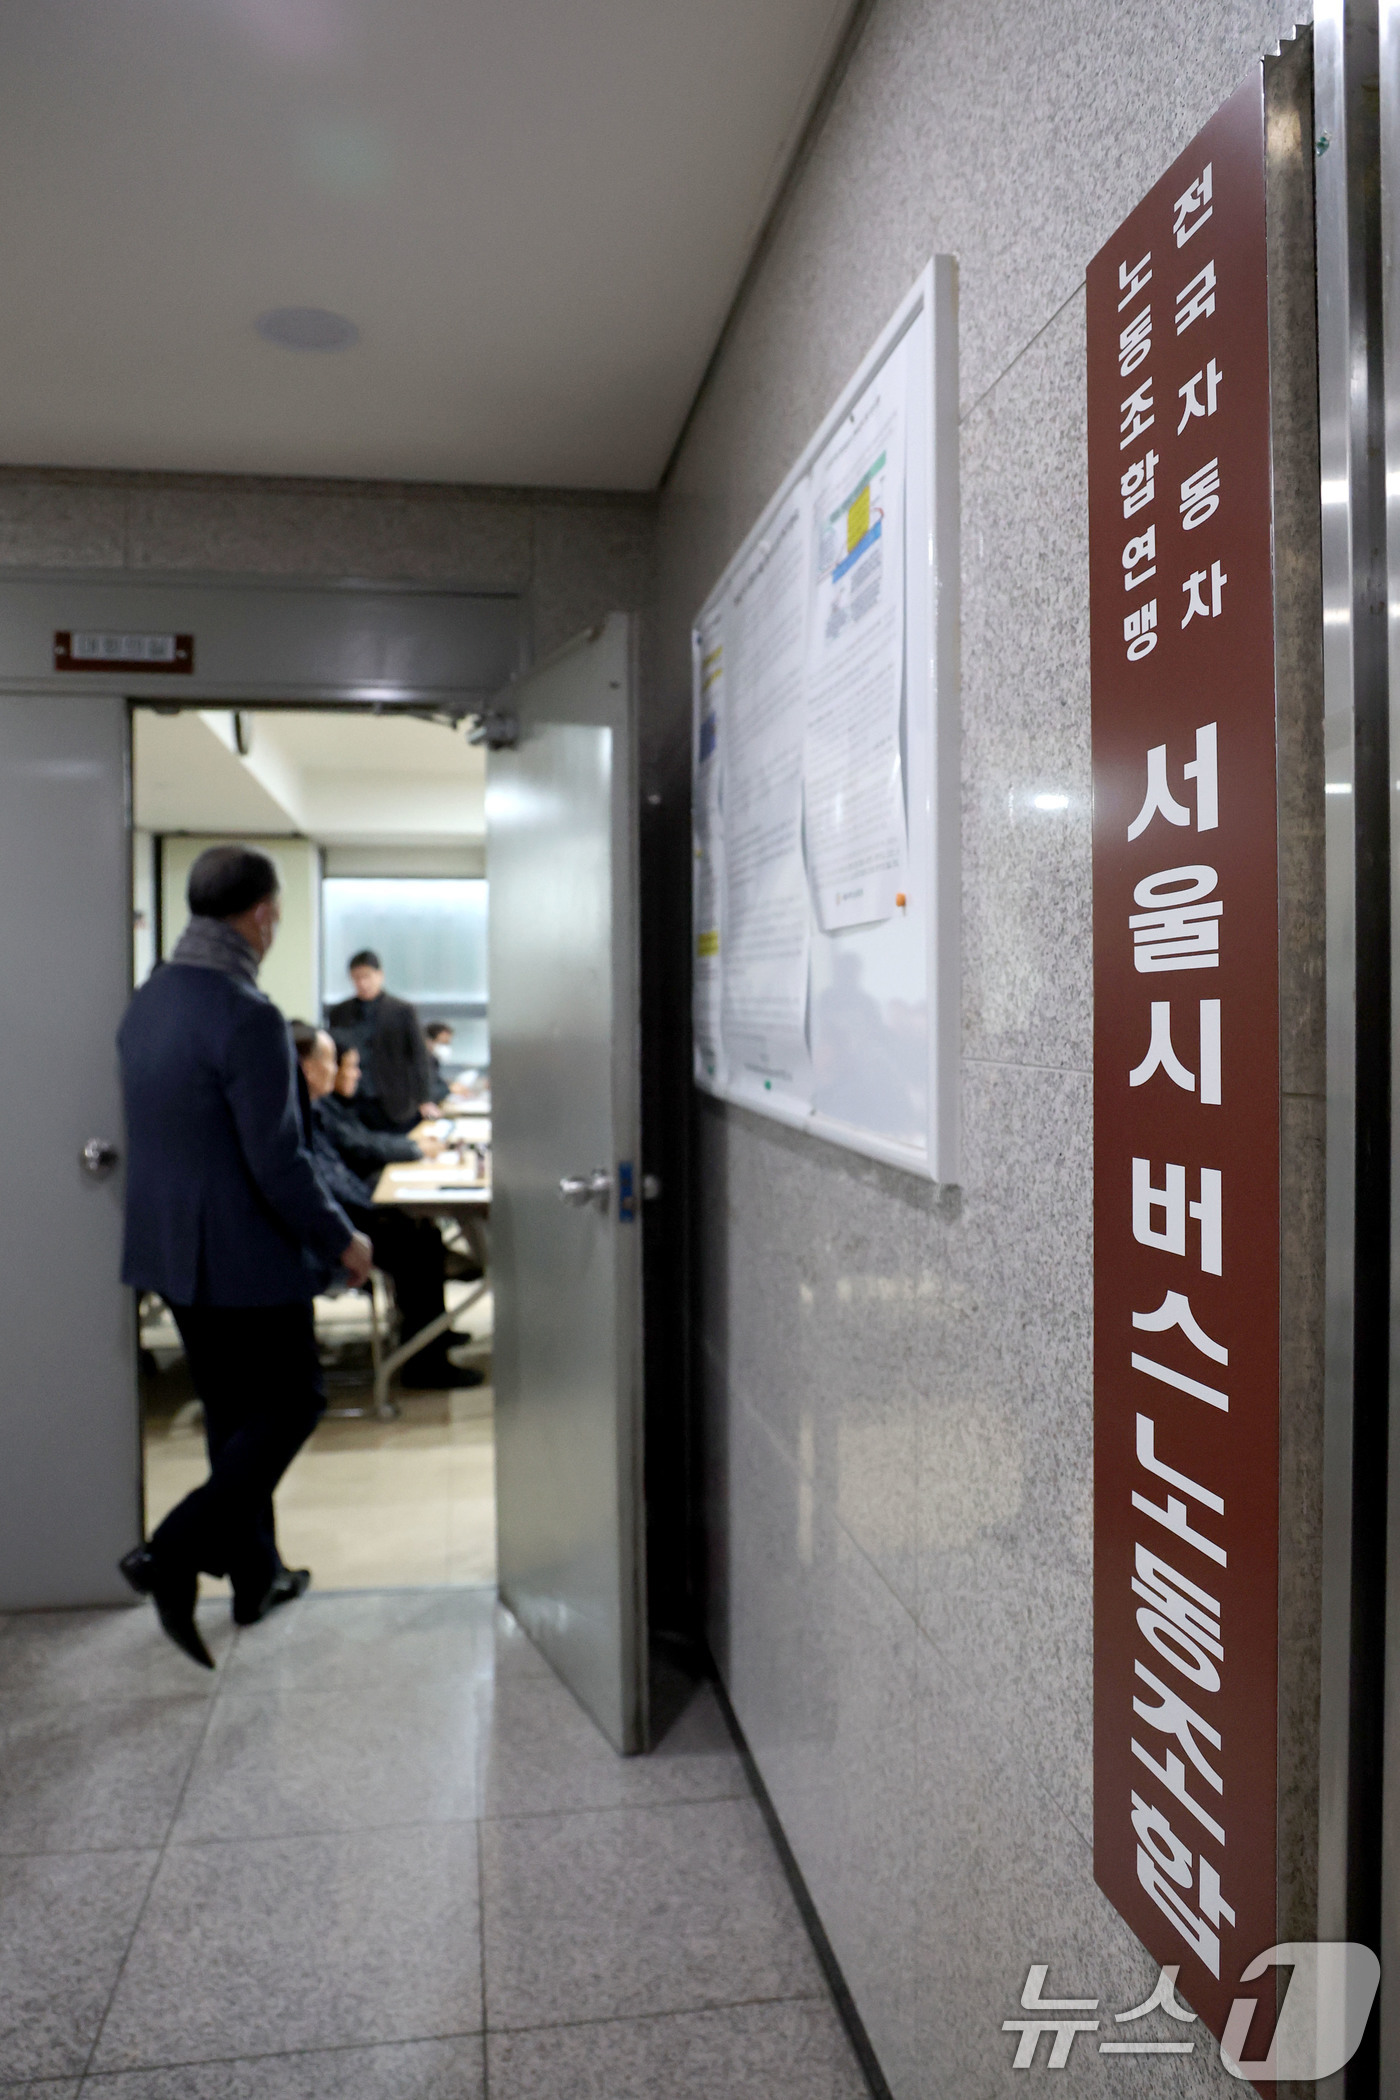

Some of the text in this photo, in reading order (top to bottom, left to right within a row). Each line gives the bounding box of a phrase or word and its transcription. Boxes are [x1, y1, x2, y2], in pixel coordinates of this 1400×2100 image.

[1118, 251, 1159, 662] 노동조합연맹
[1173, 162, 1227, 629] 전국자동차
[1127, 721, 1236, 1981] 서울시버스노동조합
